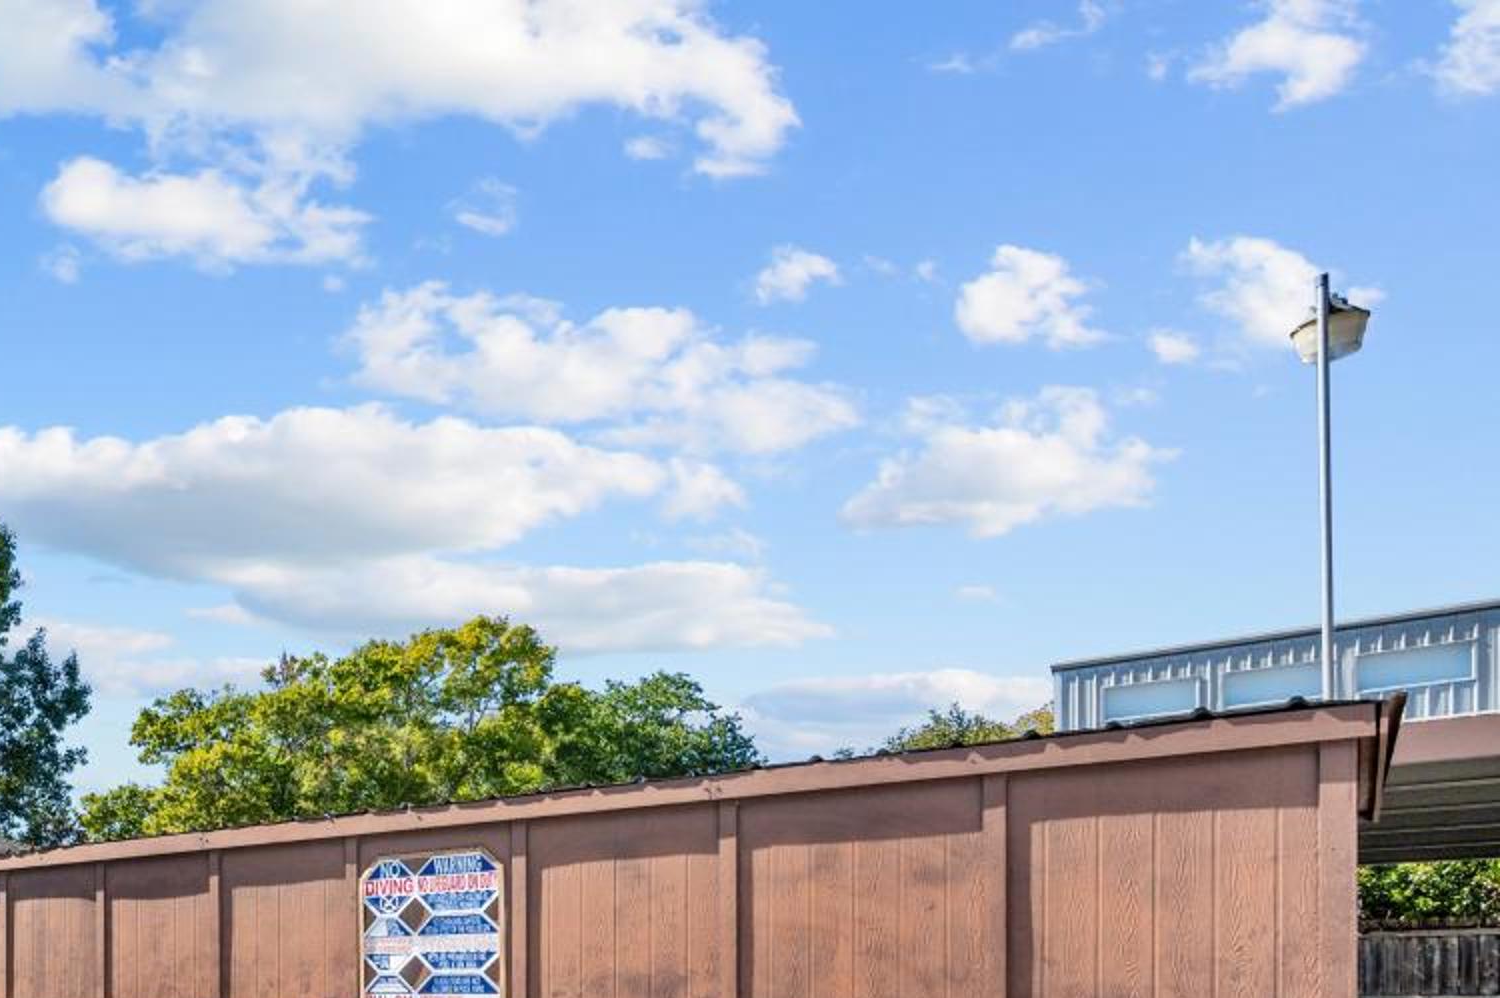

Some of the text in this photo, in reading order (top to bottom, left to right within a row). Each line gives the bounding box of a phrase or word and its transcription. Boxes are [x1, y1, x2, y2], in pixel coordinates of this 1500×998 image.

[379, 863, 400, 878] NO
[433, 856, 482, 875] WARNING
[365, 879, 413, 896] DIVING
